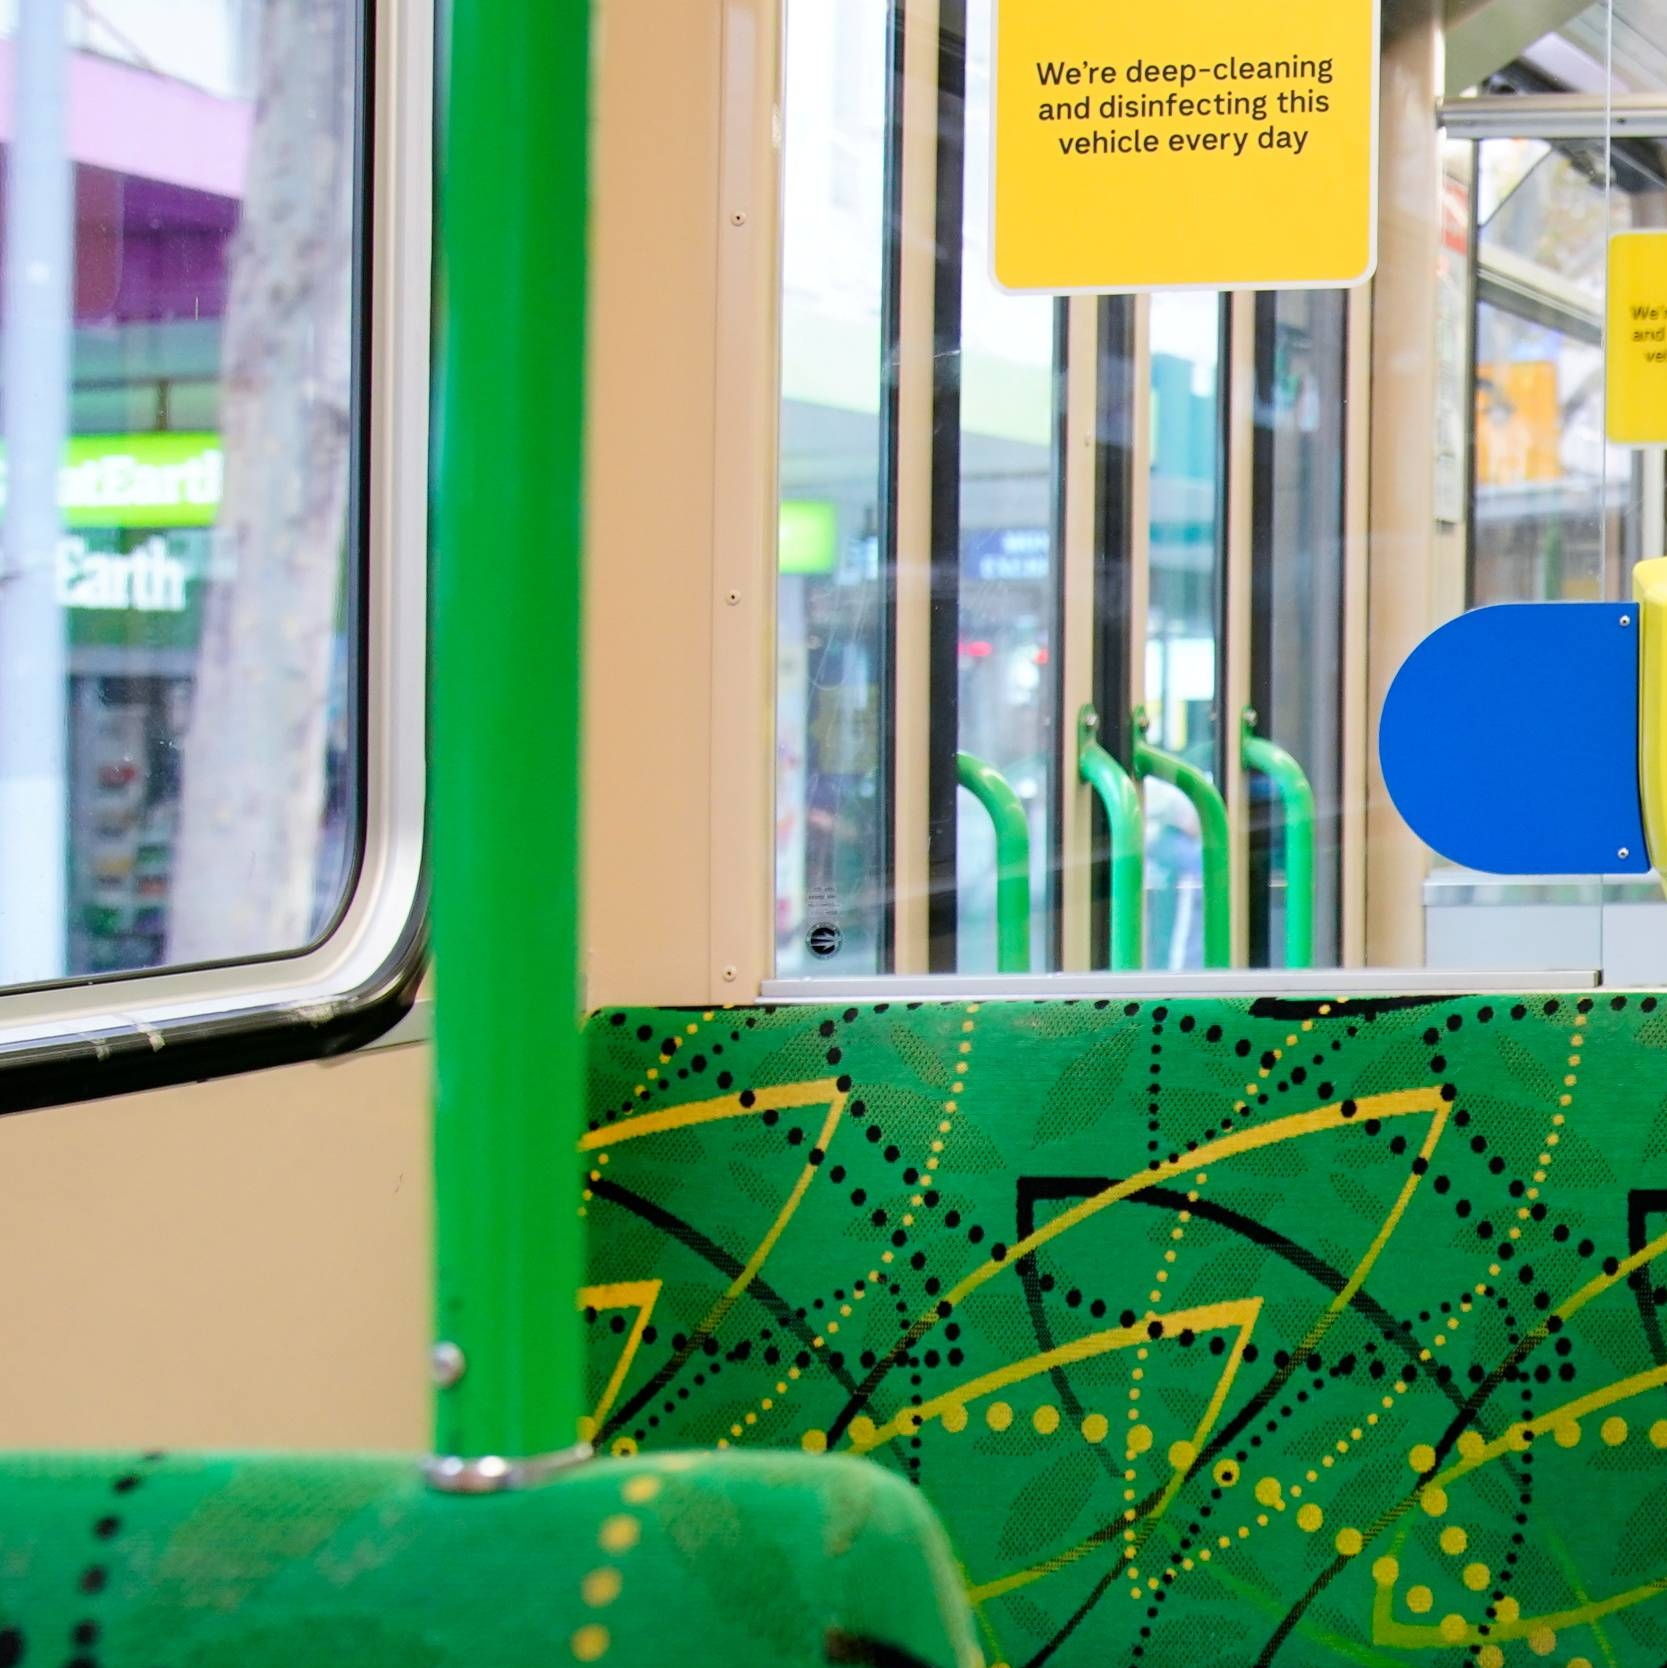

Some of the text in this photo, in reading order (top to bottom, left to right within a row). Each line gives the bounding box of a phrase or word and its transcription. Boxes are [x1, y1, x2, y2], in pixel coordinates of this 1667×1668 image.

[1036, 54, 1333, 88] We're deep-cleaning
[1038, 89, 1330, 121] and disinfecting this
[1058, 125, 1309, 156] vehicle every day
[1632, 326, 1665, 343] and
